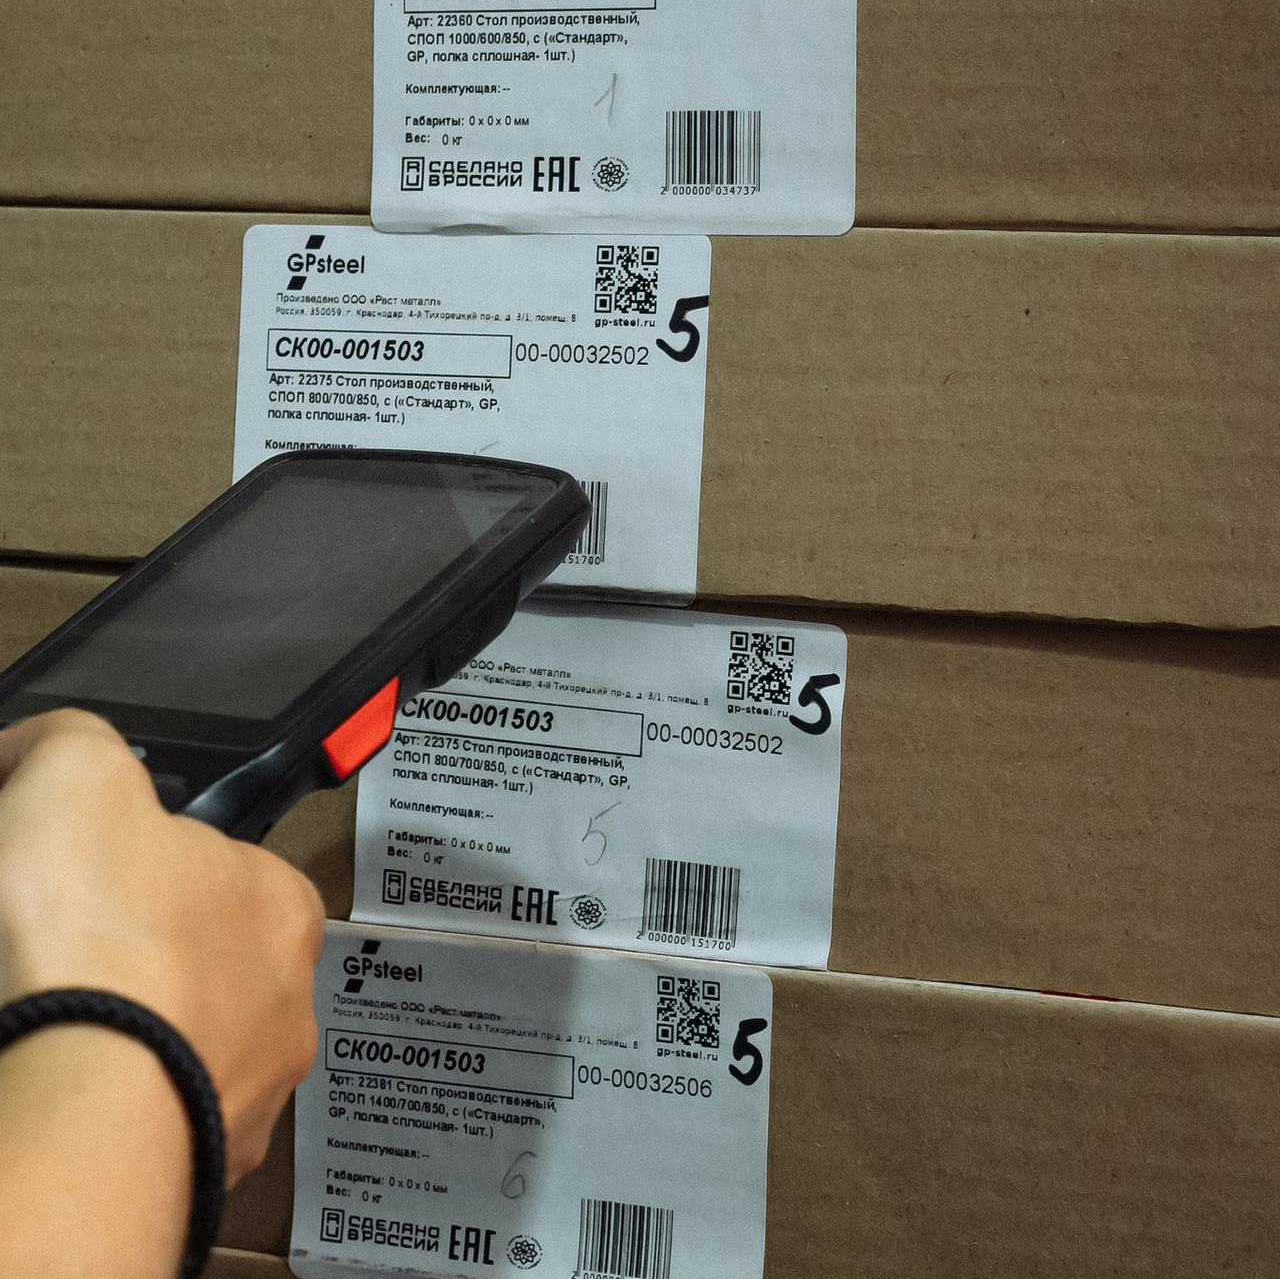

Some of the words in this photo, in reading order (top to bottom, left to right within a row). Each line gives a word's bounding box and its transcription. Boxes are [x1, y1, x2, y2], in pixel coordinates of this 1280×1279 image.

[407, 15, 433, 29] Арт:
[437, 14, 473, 27] 22360
[475, 15, 507, 27] Стол
[511, 10, 640, 28] производственный,
[407, 33, 445, 45] СПОП
[405, 84, 501, 96] Комплектующая:
[405, 115, 464, 128] Габариты:
[428, 160, 523, 174] СДЕЛАНО
[286, 253, 365, 275] GPsteel
[594, 317, 656, 328] gp-steel.ru
[656, 296, 709, 362] 5
[514, 342, 649, 366] 00-00032502
[268, 372, 294, 387] Арт:
[297, 373, 333, 387] 22375
[334, 376, 367, 388] Стол
[369, 374, 495, 394] производственный,
[268, 390, 305, 403] СПОП
[478, 397, 501, 412] GP,
[267, 408, 302, 420] полка
[562, 555, 601, 565] 51700
[726, 703, 789, 718] gp-steel.ru
[789, 673, 840, 735] 5
[646, 721, 783, 755] 00-00032502
[393, 731, 420, 747] Арт:
[423, 735, 460, 751] 22375
[461, 740, 494, 754] Стол
[496, 742, 626, 771] производственный,
[393, 749, 431, 765] СПОП
[607, 774, 631, 790] GP,
[389, 798, 485, 819] Комплектующая:
[387, 829, 447, 847] Габариты:
[582, 802, 622, 866] 5
[409, 876, 504, 900] СДЕЛАНО
[342, 955, 423, 983] GPsteel
[656, 1047, 719, 1062] gp-steel.ru
[727, 1018, 768, 1086] 5
[328, 1072, 354, 1087] Арт:
[358, 1075, 393, 1091] 22381
[395, 1081, 428, 1096] Стол
[430, 1086, 558, 1113] производственный,
[577, 1064, 712, 1099] 00-00032506
[328, 1090, 366, 1106] СПОП
[326, 1138, 420, 1159] Комплектующая:
[326, 1168, 384, 1185] Габариты:
[501, 1151, 536, 1199] 6
[347, 1214, 440, 1240] СДЕЛАНО
